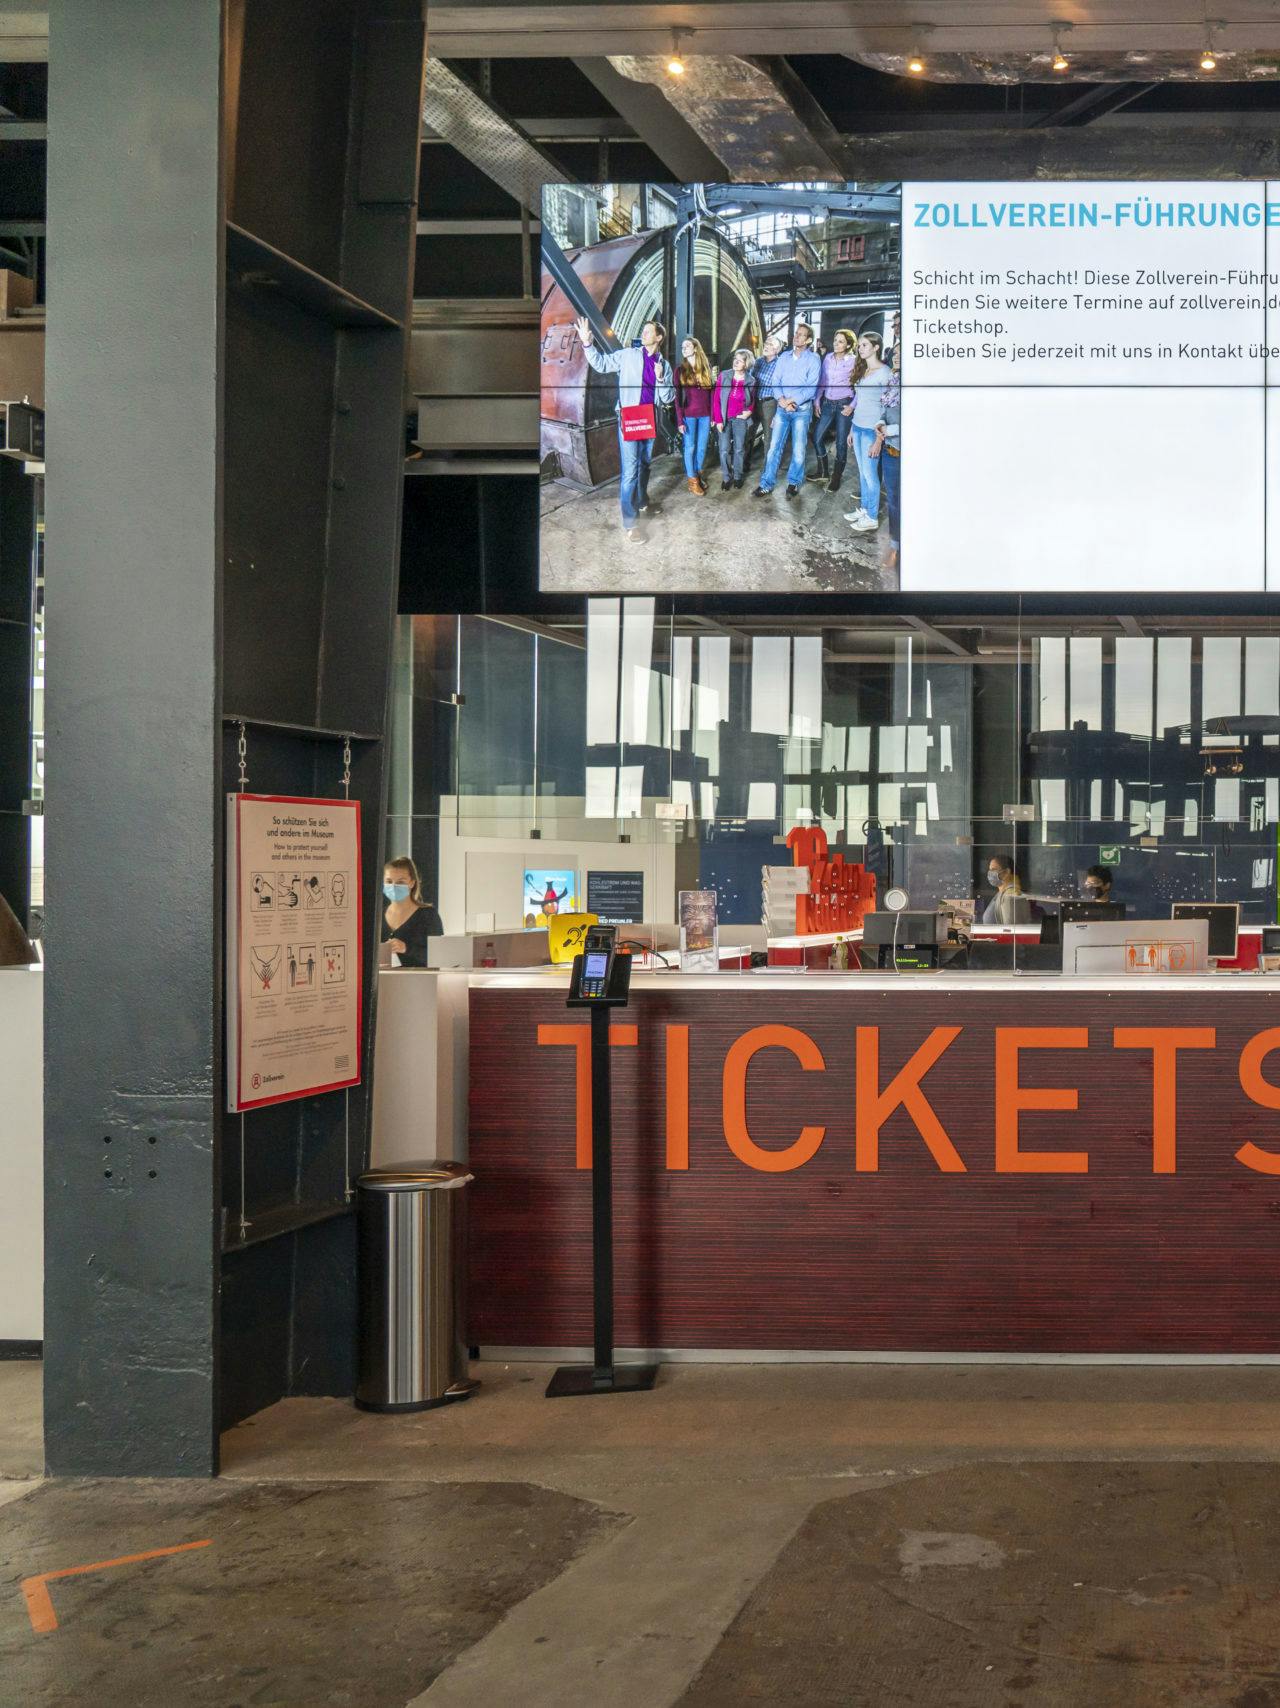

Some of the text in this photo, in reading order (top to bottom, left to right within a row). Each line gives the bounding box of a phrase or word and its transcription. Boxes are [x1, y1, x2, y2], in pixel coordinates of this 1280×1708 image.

[913, 270, 975, 286] Schicht
[980, 270, 1000, 285] im
[1005, 269, 1078, 286] Schacht!
[1084, 269, 1130, 285] Diese
[913, 294, 970, 310] Finden
[975, 294, 1001, 310] Sie
[1005, 294, 1068, 310] weitere
[1072, 294, 1144, 310] Termine
[1148, 294, 1175, 310] auf
[912, 318, 1008, 338] Ticketshop.
[913, 343, 976, 359] Bleiben
[981, 343, 1007, 359] Sie
[1010, 343, 1085, 363] jederzeit
[1090, 343, 1117, 359] mit
[1122, 347, 1153, 359] uns
[1158, 343, 1173, 359] in
[1178, 343, 1244, 359] Kontakt
[272, 815, 329, 827] So schützen Sie sich
[266, 827, 334, 838] und andere im Museum
[292, 844, 310, 852] protect
